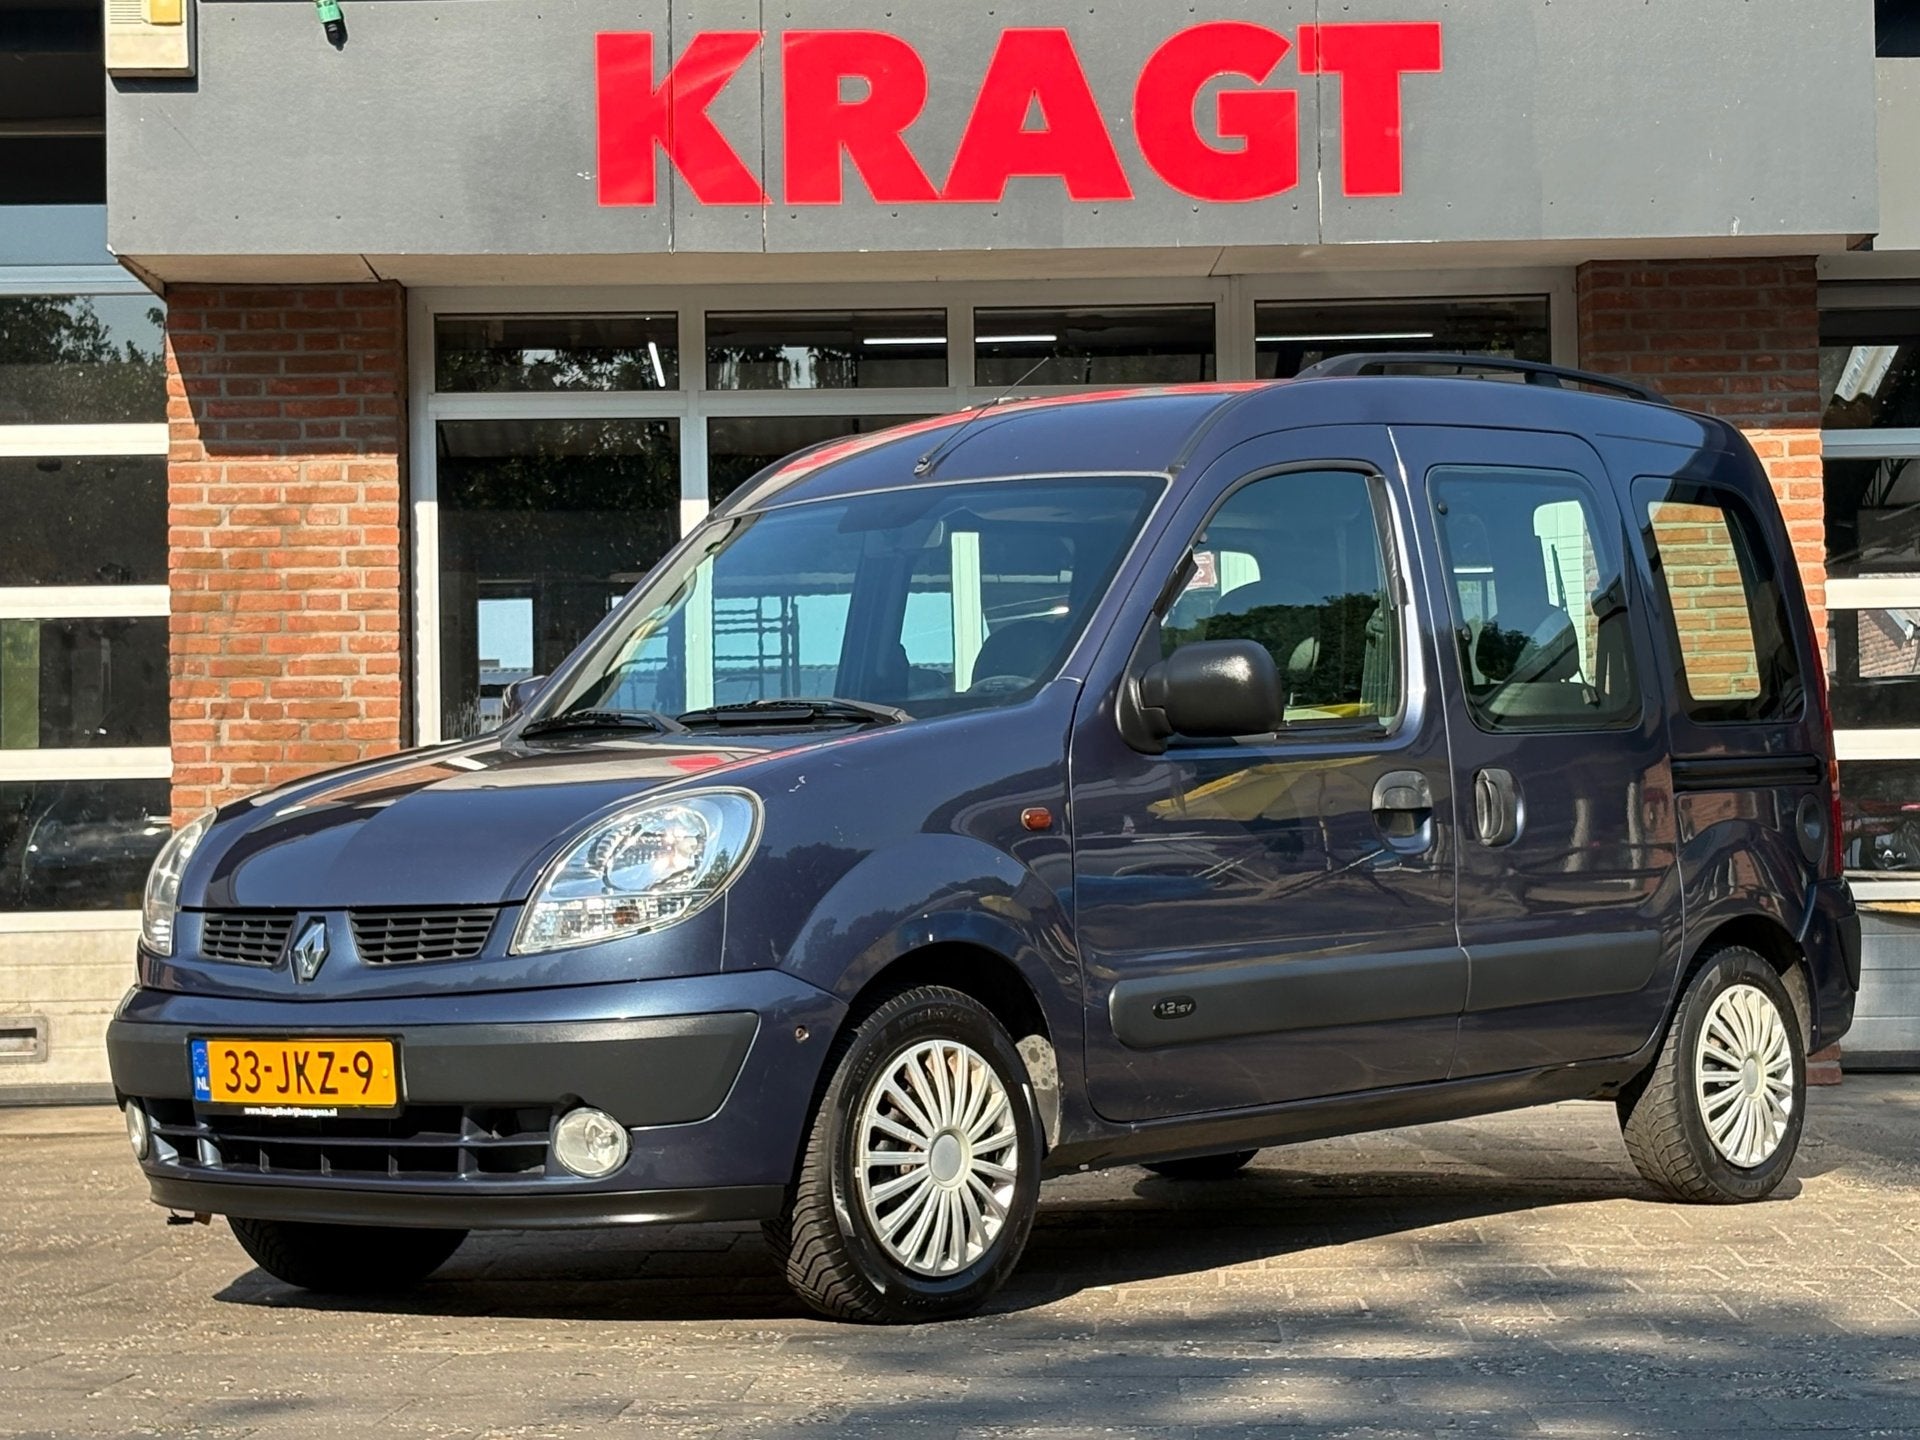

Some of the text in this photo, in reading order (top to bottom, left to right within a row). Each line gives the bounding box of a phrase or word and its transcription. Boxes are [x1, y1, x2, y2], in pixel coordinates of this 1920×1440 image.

[595, 22, 1443, 207] KRAGT
[196, 1076, 210, 1090] NL
[224, 1050, 374, 1095] 33-JKZ-9
